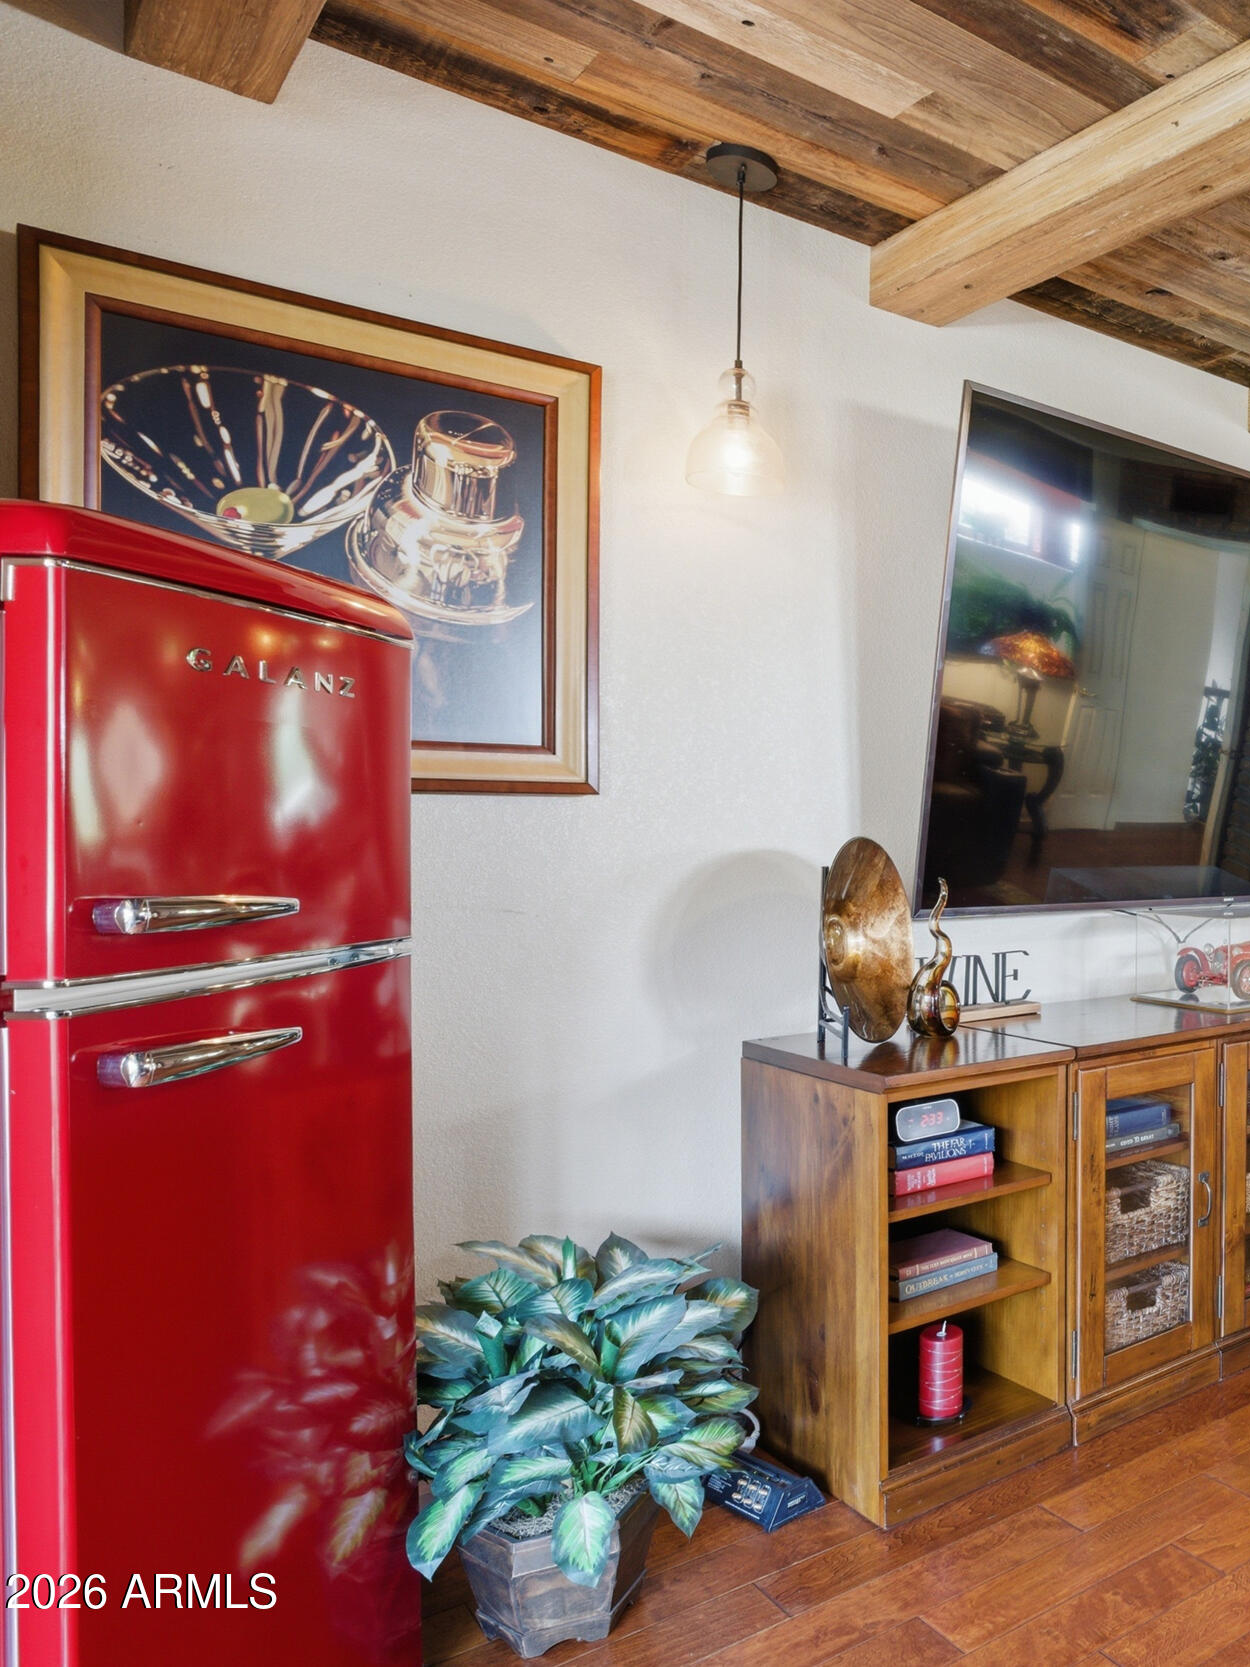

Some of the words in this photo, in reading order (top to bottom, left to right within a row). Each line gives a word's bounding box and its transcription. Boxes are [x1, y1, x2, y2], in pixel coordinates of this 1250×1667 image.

[186, 648, 355, 698] GALANZ
[915, 950, 1031, 1006] INE
[925, 1147, 967, 1162] PAVILIONS
[931, 1140, 951, 1152] THE
[951, 1136, 966, 1148] FAR
